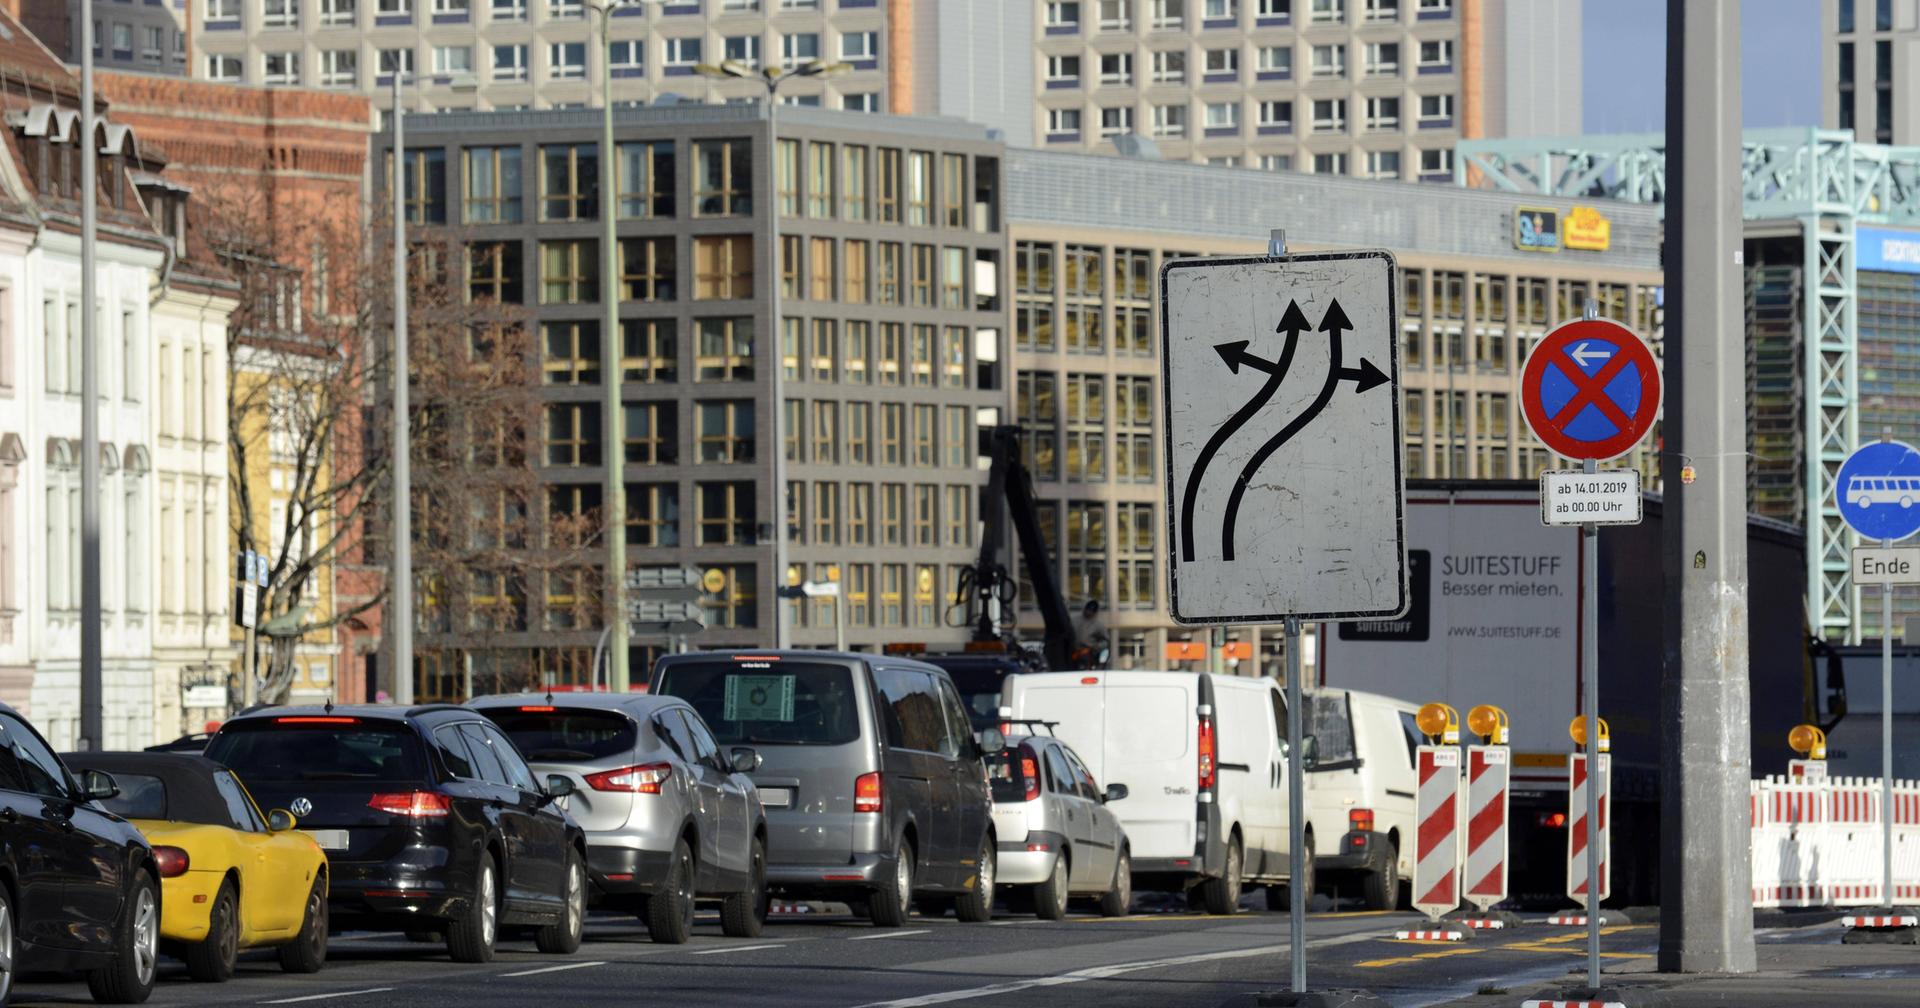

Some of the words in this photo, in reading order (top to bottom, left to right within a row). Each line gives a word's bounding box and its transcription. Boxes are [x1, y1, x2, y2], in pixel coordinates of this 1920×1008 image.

[1558, 483, 1571, 494] ab
[1575, 482, 1627, 494] 14.01.2019
[1556, 503, 1569, 513] ab
[1572, 501, 1600, 512] 00.00
[1602, 501, 1623, 512] Uhr
[1442, 555, 1561, 576] SUITESTUFF
[1862, 557, 1910, 575] Ende
[1442, 581, 1494, 597] Besser
[1499, 582, 1563, 597] mieten.
[1356, 621, 1412, 633] SUITESTUFF
